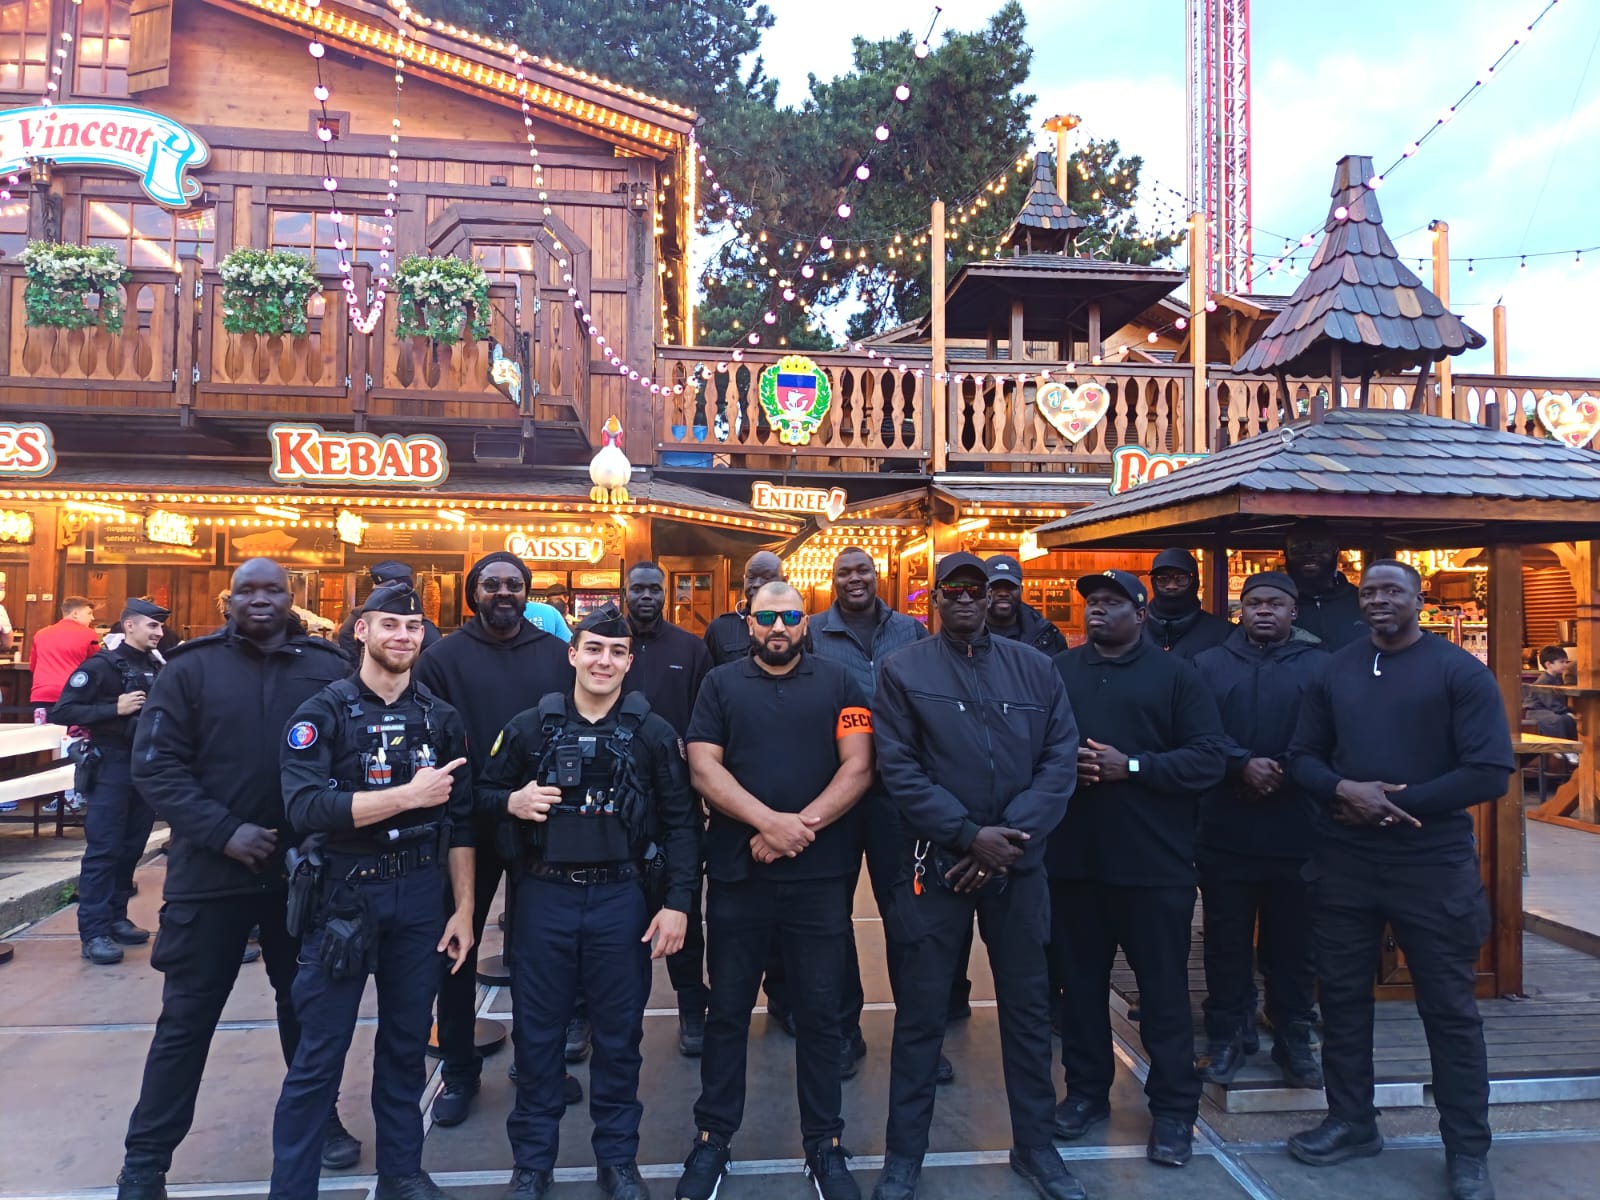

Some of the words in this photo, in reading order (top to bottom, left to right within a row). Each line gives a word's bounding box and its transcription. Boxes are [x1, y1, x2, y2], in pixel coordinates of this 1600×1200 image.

[19, 113, 154, 157] Vincent
[275, 432, 438, 477] KEBAB
[757, 488, 827, 510] ENTREE
[508, 536, 587, 558] CAISSE
